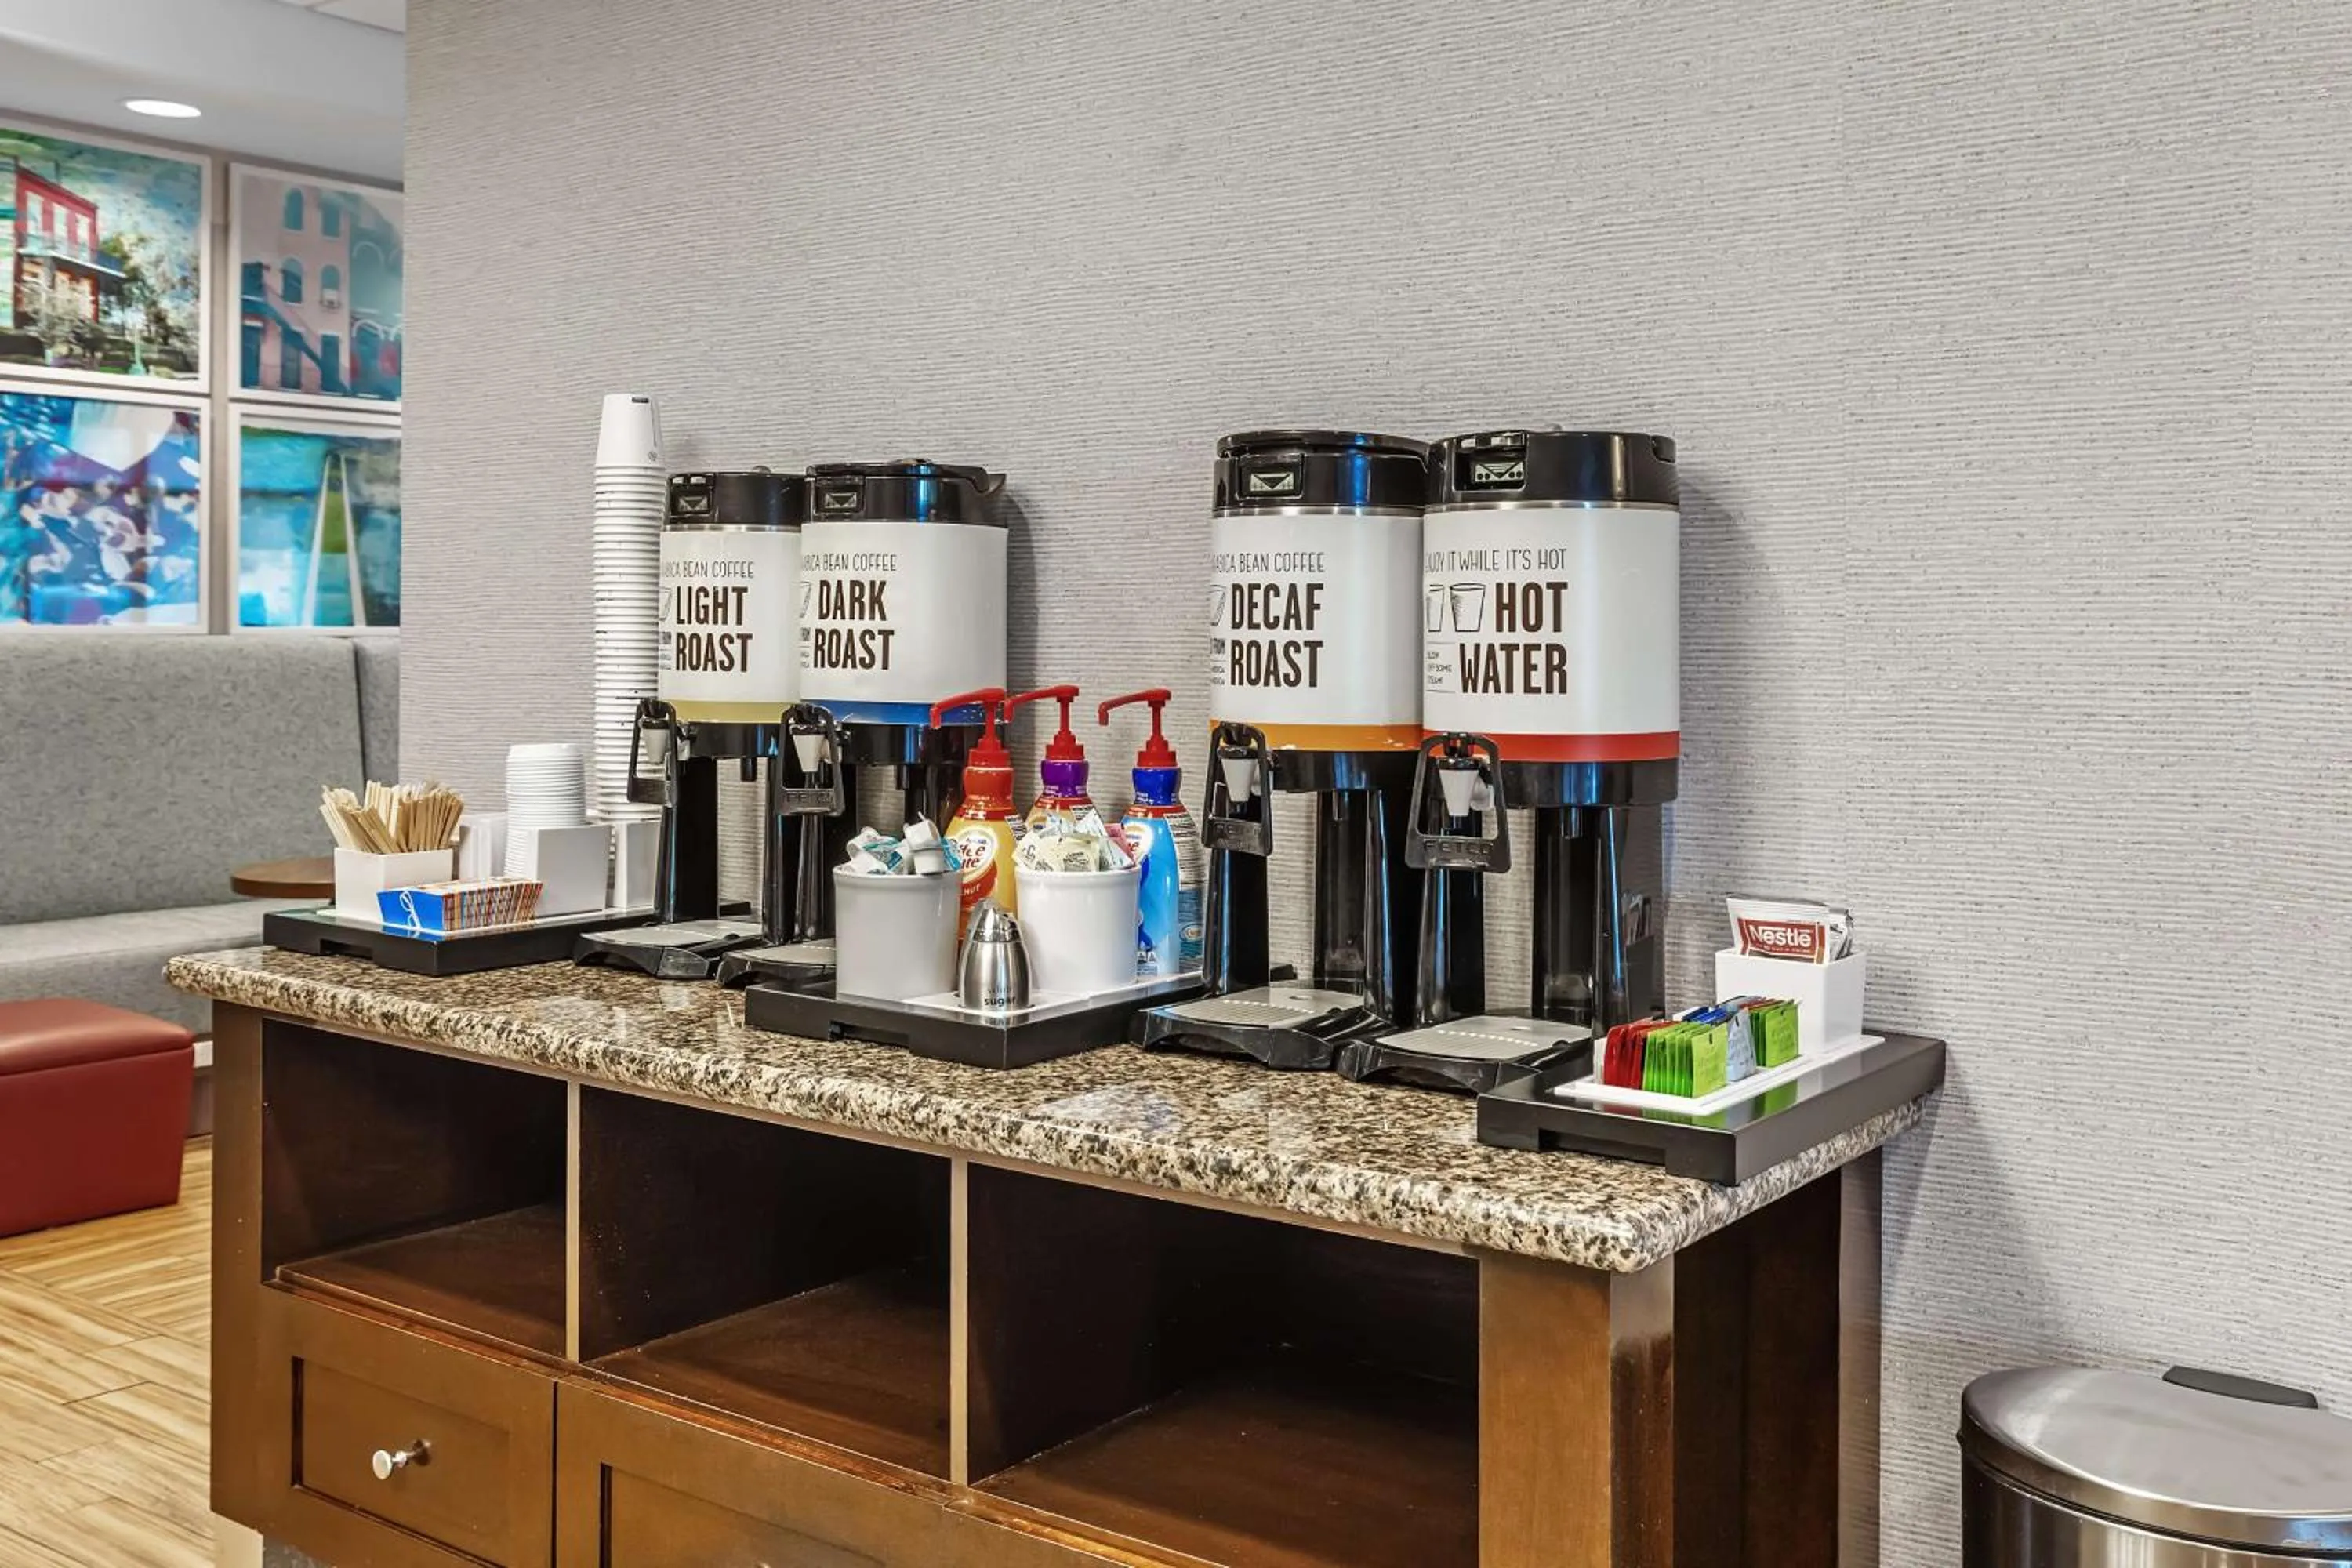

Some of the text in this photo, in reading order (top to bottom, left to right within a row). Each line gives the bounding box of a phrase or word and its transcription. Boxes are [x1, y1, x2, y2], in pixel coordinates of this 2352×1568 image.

[683, 561, 708, 578] BEAN
[712, 560, 755, 579] COFFEE
[823, 554, 849, 571] BEAN
[853, 553, 898, 572] COFFEE
[1240, 553, 1269, 573] BEAN
[1274, 552, 1325, 573] COFFEE
[1448, 551, 1456, 572] IT
[1459, 550, 1500, 572] WHILE
[1506, 550, 1531, 571] IT'S
[1538, 549, 1567, 571] HOT
[677, 586, 749, 626] LIGHT
[818, 580, 887, 621] DARK
[1231, 583, 1324, 630] DECAF
[1495, 582, 1568, 633] HOT
[676, 633, 753, 673] ROAST
[814, 628, 895, 670] ROAST
[1230, 639, 1323, 688] ROAST
[1459, 643, 1567, 694] WATER
